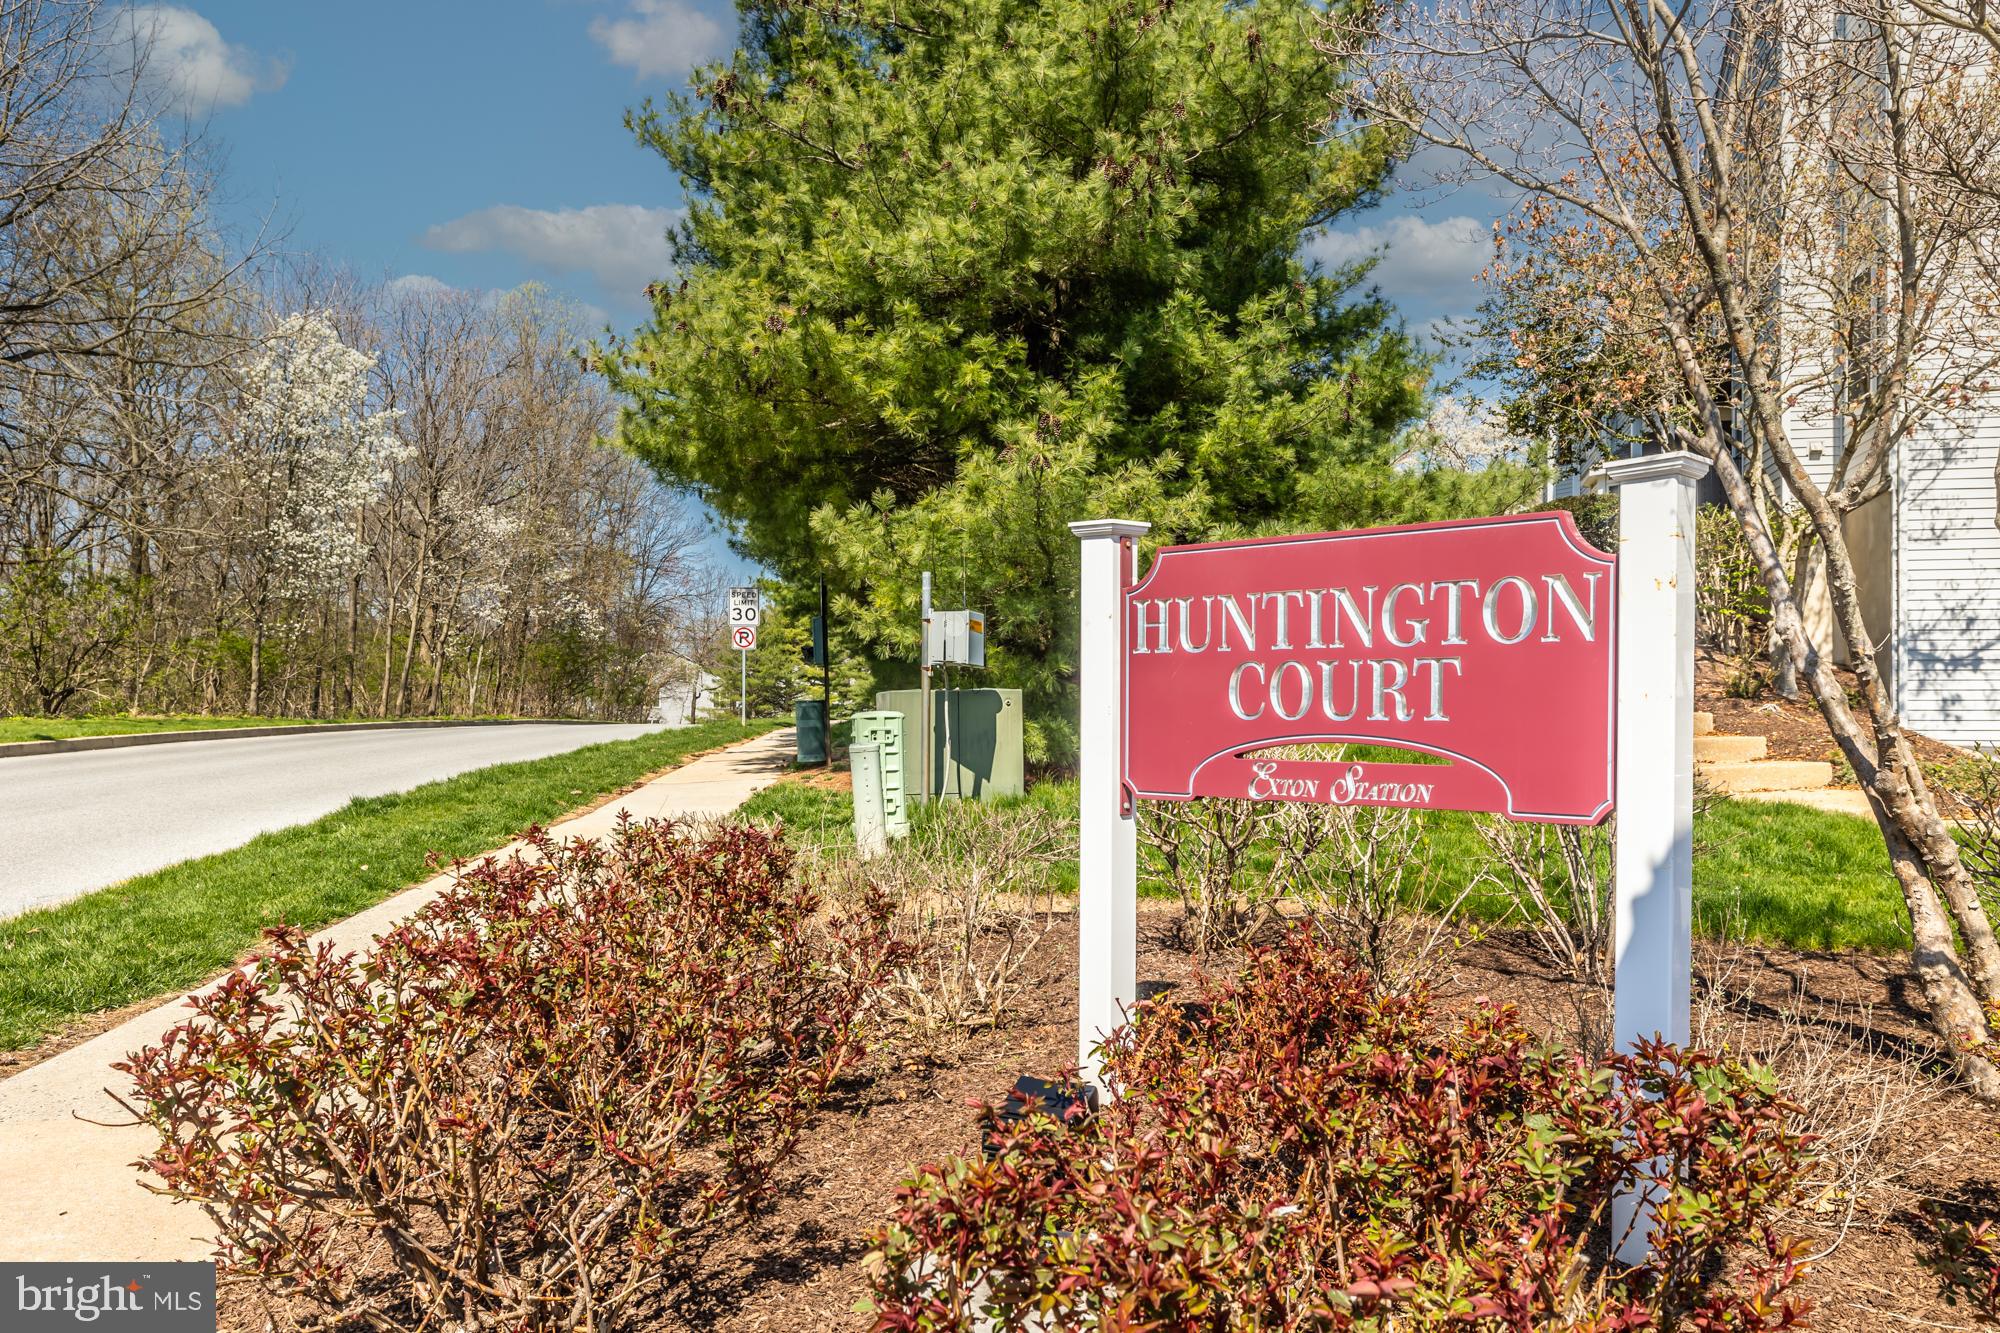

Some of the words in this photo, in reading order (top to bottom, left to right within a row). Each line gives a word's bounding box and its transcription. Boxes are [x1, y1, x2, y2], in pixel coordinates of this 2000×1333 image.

[732, 608, 756, 621] 30
[1132, 571, 1603, 655] HUNTINGTON
[1228, 656, 1462, 722] COURT
